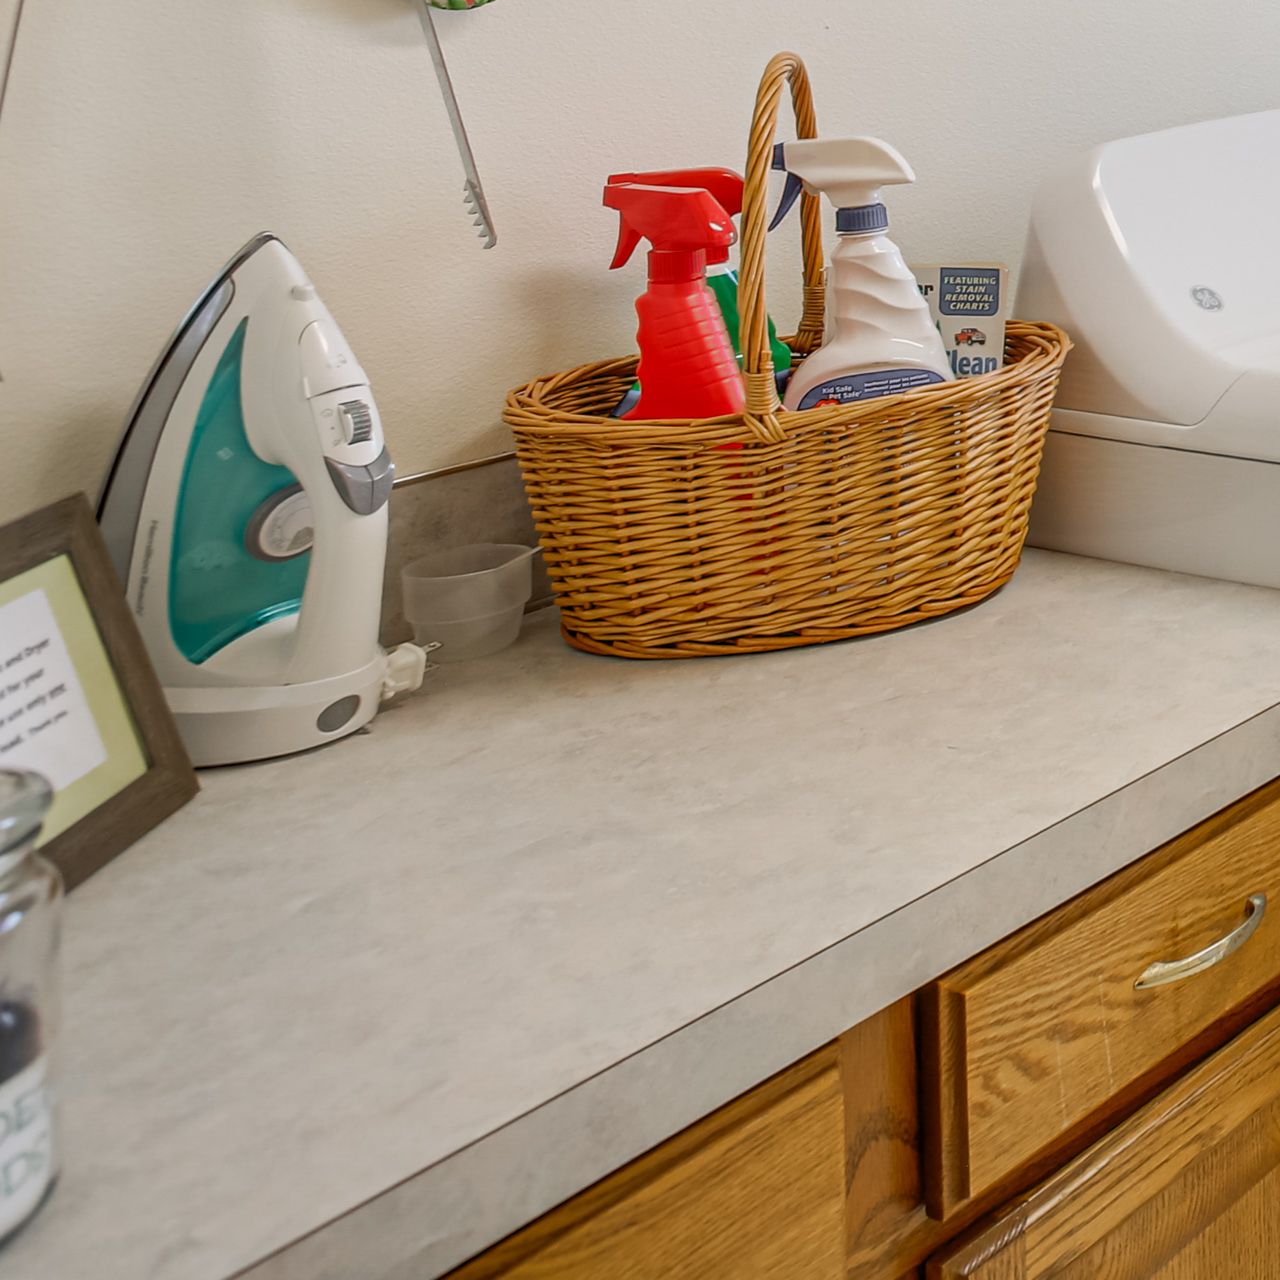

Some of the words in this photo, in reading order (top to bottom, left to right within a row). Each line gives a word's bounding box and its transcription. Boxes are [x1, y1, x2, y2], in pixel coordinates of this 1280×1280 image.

[944, 276, 997, 285] FEATURING
[954, 285, 986, 293] STAIN
[944, 293, 994, 301] REMOVAL
[949, 302, 990, 310] CHARTS
[946, 349, 998, 376] lean
[822, 386, 834, 394] Kid
[835, 385, 852, 393] Safe
